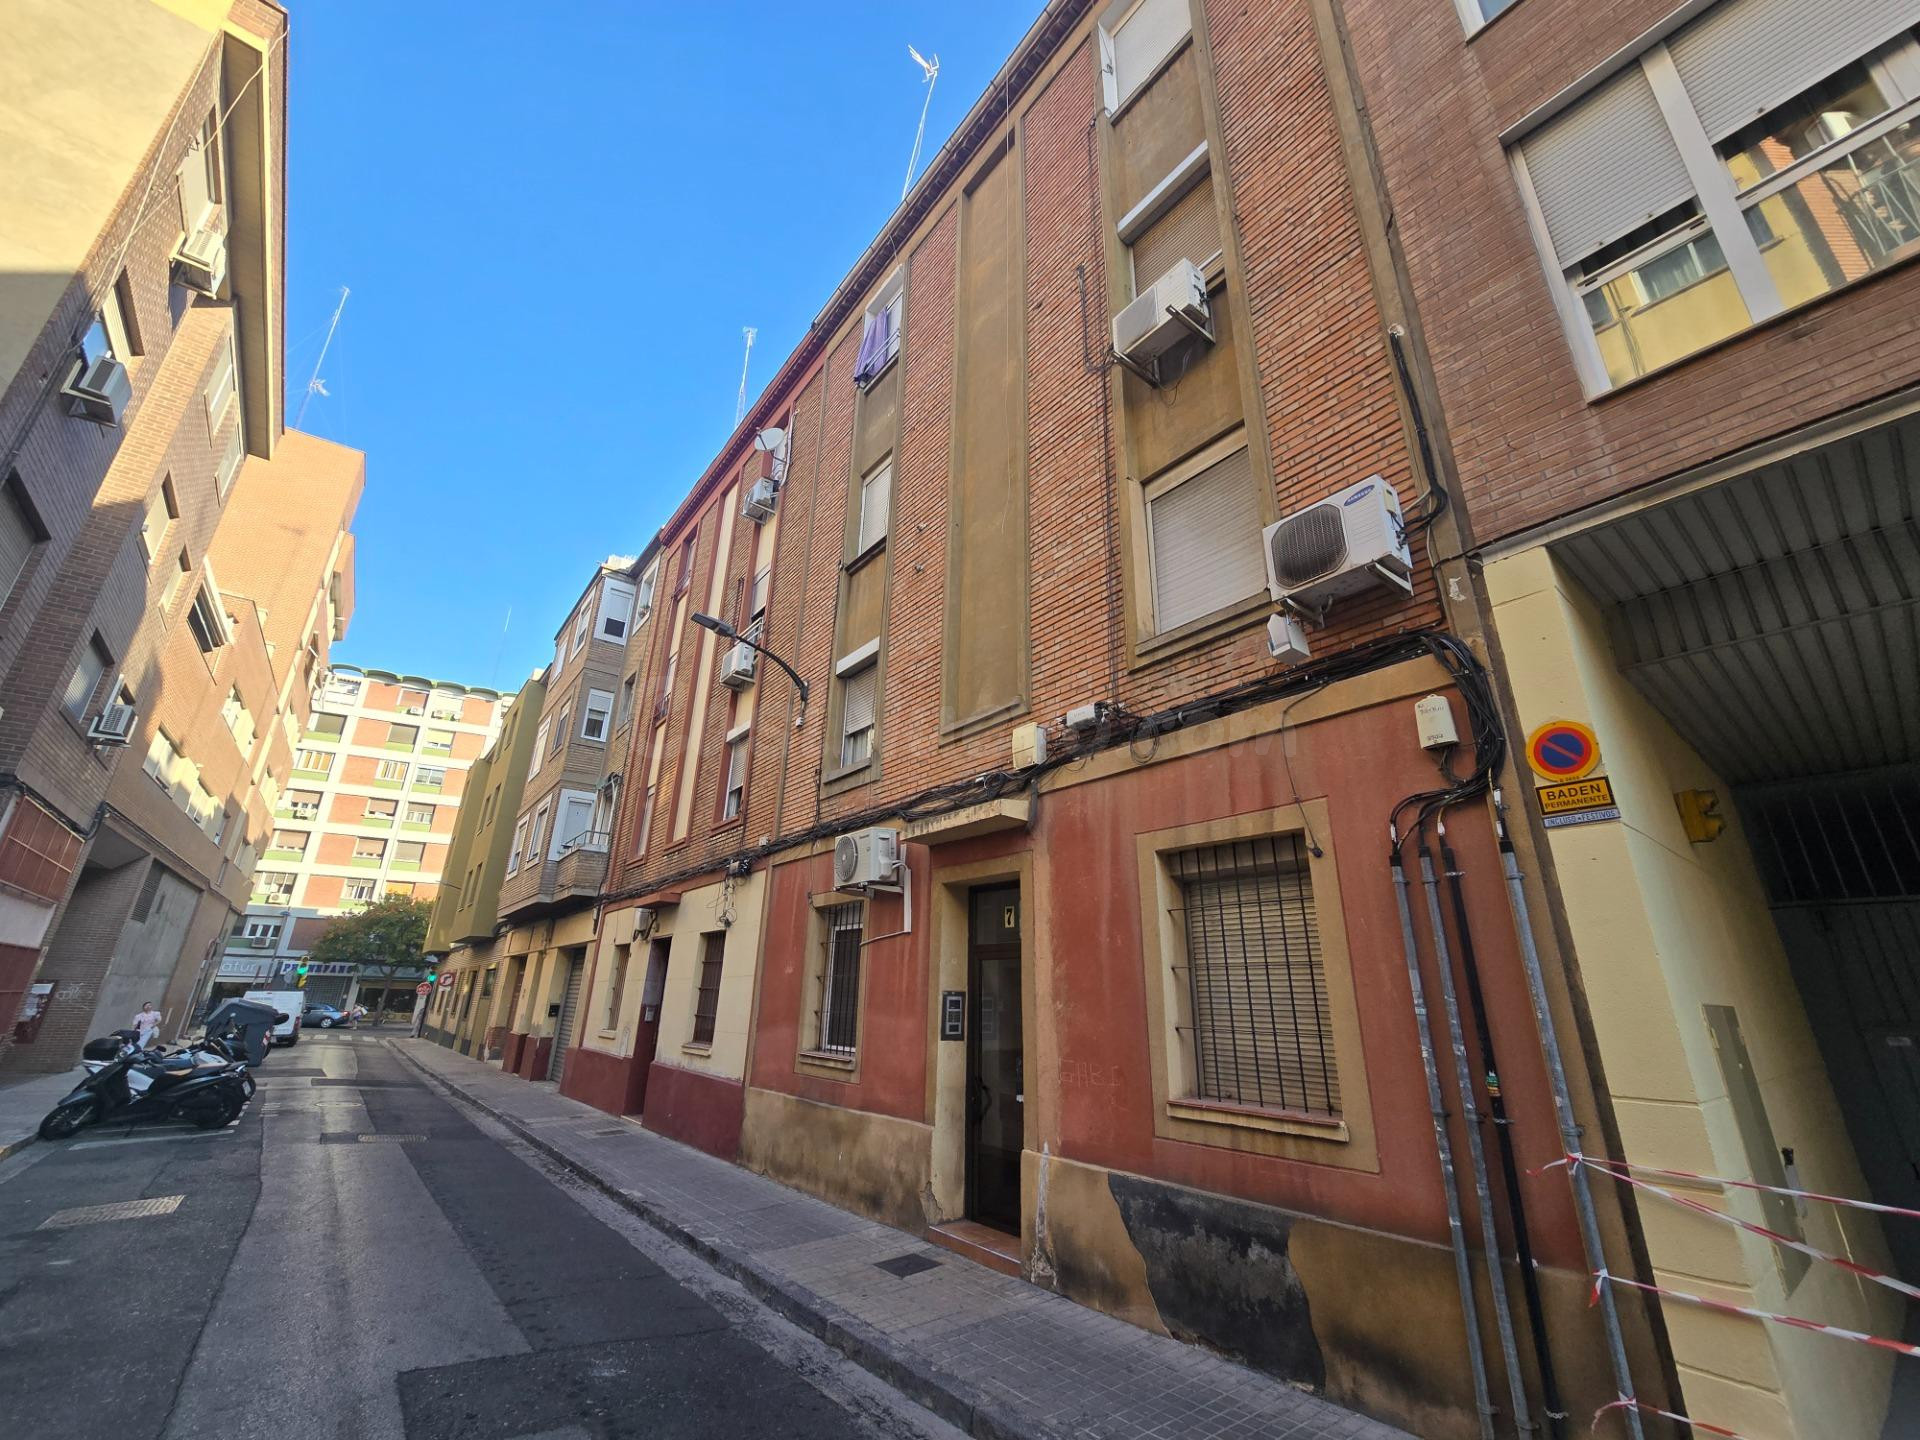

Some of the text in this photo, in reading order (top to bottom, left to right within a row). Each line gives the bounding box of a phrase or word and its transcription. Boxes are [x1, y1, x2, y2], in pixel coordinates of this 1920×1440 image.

[1546, 784, 1601, 801] BADEN
[1545, 794, 1609, 809] PERMANENTE
[1582, 810, 1616, 822] FESTIVOS
[1005, 908, 1013, 926] 7
